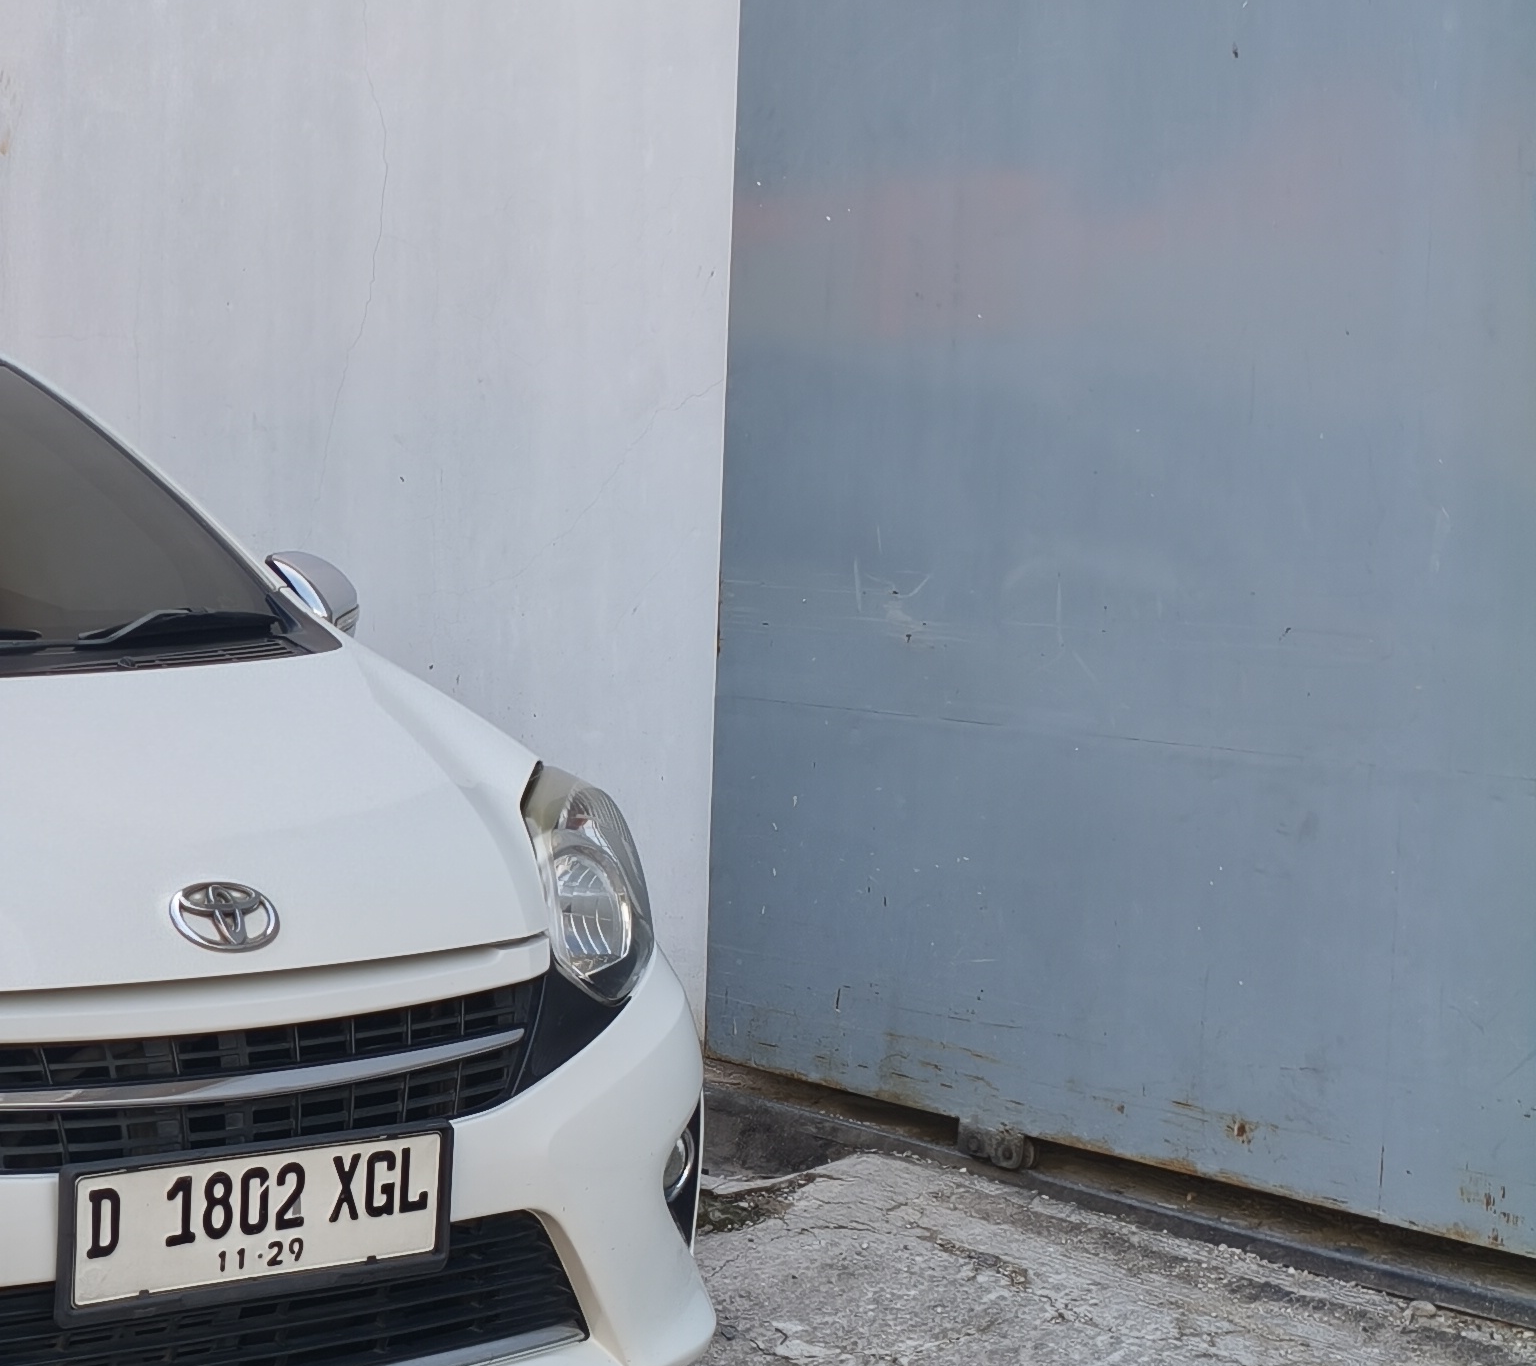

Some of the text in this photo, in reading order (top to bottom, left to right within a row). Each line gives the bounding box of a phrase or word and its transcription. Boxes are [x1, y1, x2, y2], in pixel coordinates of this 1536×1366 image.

[86, 1146, 429, 1260] D 1802 XGL
